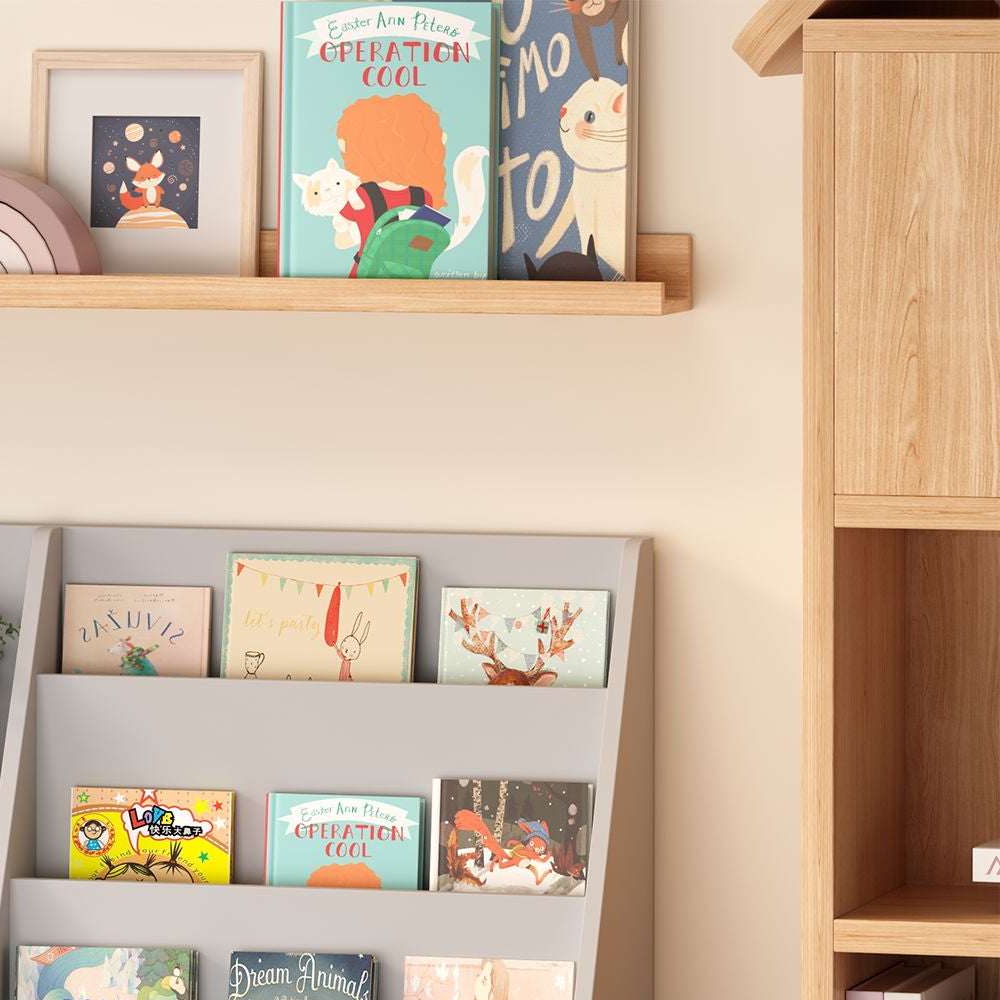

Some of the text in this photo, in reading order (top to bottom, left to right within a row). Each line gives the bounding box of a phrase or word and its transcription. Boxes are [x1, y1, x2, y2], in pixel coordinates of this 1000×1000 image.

[326, 17, 373, 39] Easter
[319, 41, 470, 63] OPERATION
[362, 65, 427, 88] COOL
[244, 610, 322, 641] let's party
[148, 824, 203, 838] 快乐大鼻子
[294, 822, 405, 842] OPERATION
[324, 841, 373, 858] COOL
